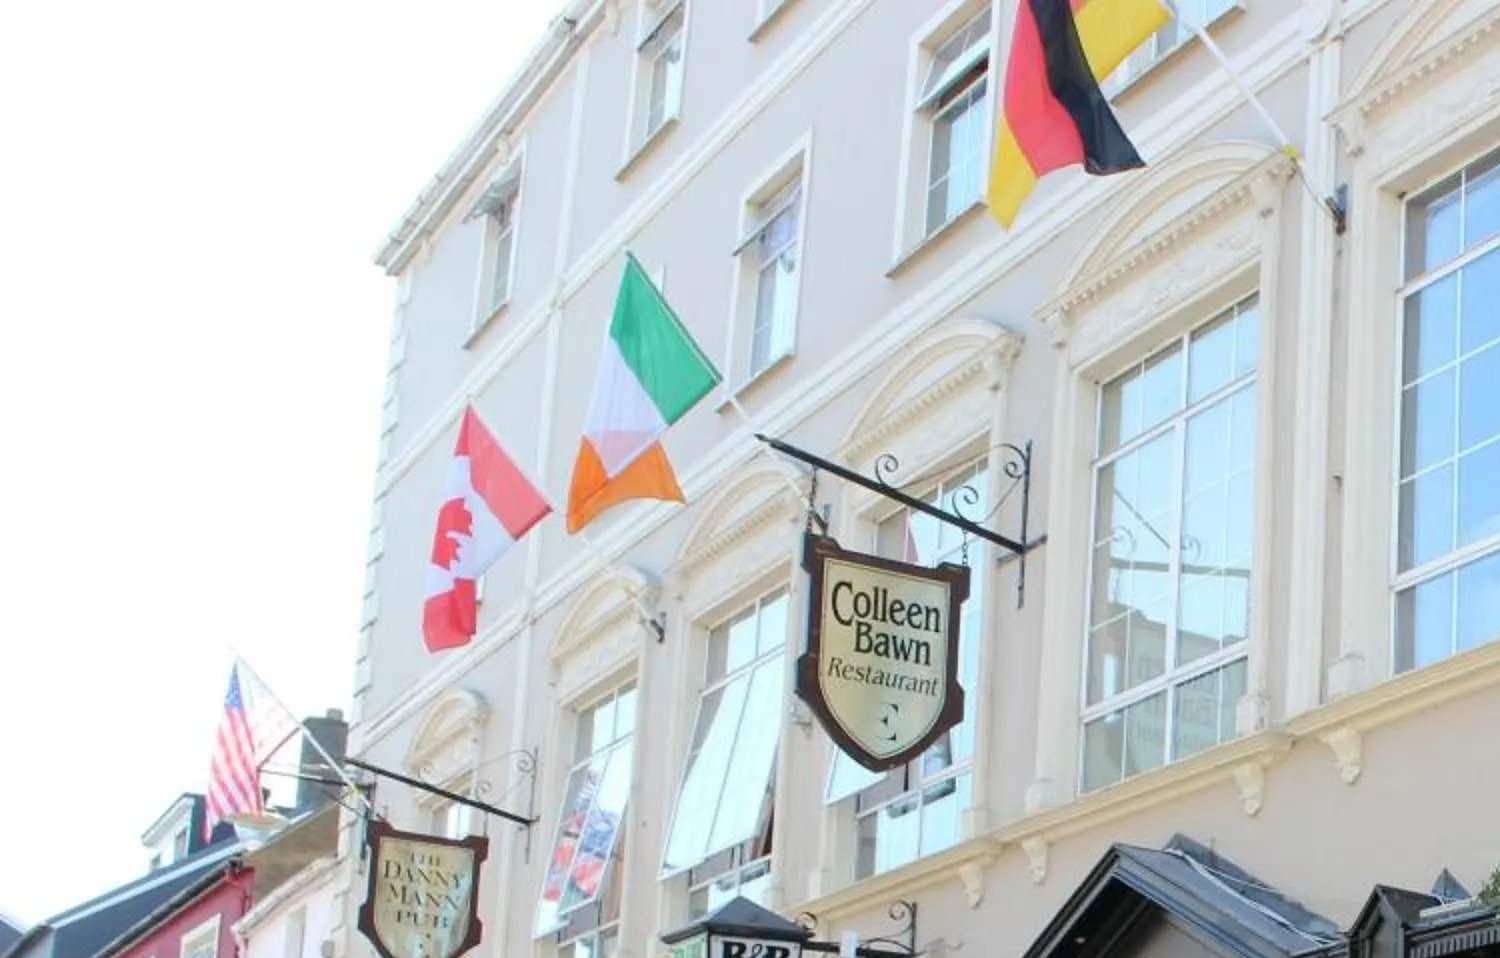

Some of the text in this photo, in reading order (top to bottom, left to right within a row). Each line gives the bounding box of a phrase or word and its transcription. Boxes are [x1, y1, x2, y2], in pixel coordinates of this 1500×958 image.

[831, 581, 941, 633] Colleen
[854, 620, 931, 666] Bawn
[827, 656, 938, 696] Restaurant
[384, 859, 466, 889] DANNY
[386, 883, 461, 911] MANN
[396, 910, 449, 929] PUB
